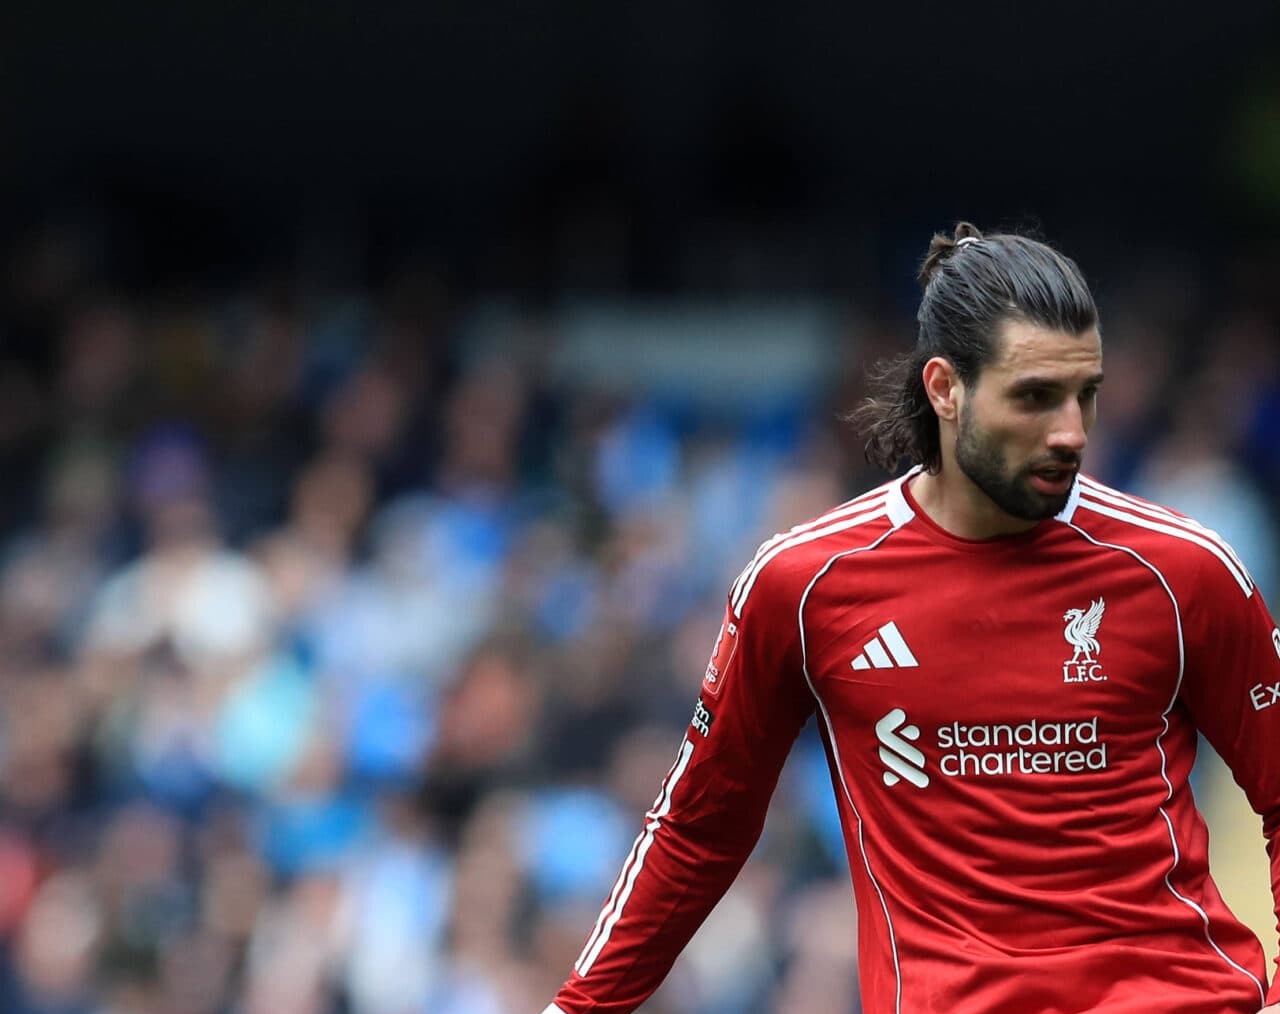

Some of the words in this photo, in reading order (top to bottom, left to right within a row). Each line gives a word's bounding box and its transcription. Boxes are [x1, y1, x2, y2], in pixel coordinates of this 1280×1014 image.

[1063, 664, 1107, 682] L.F.C.
[937, 716, 1097, 747] standard
[940, 743, 1107, 776] chartered
